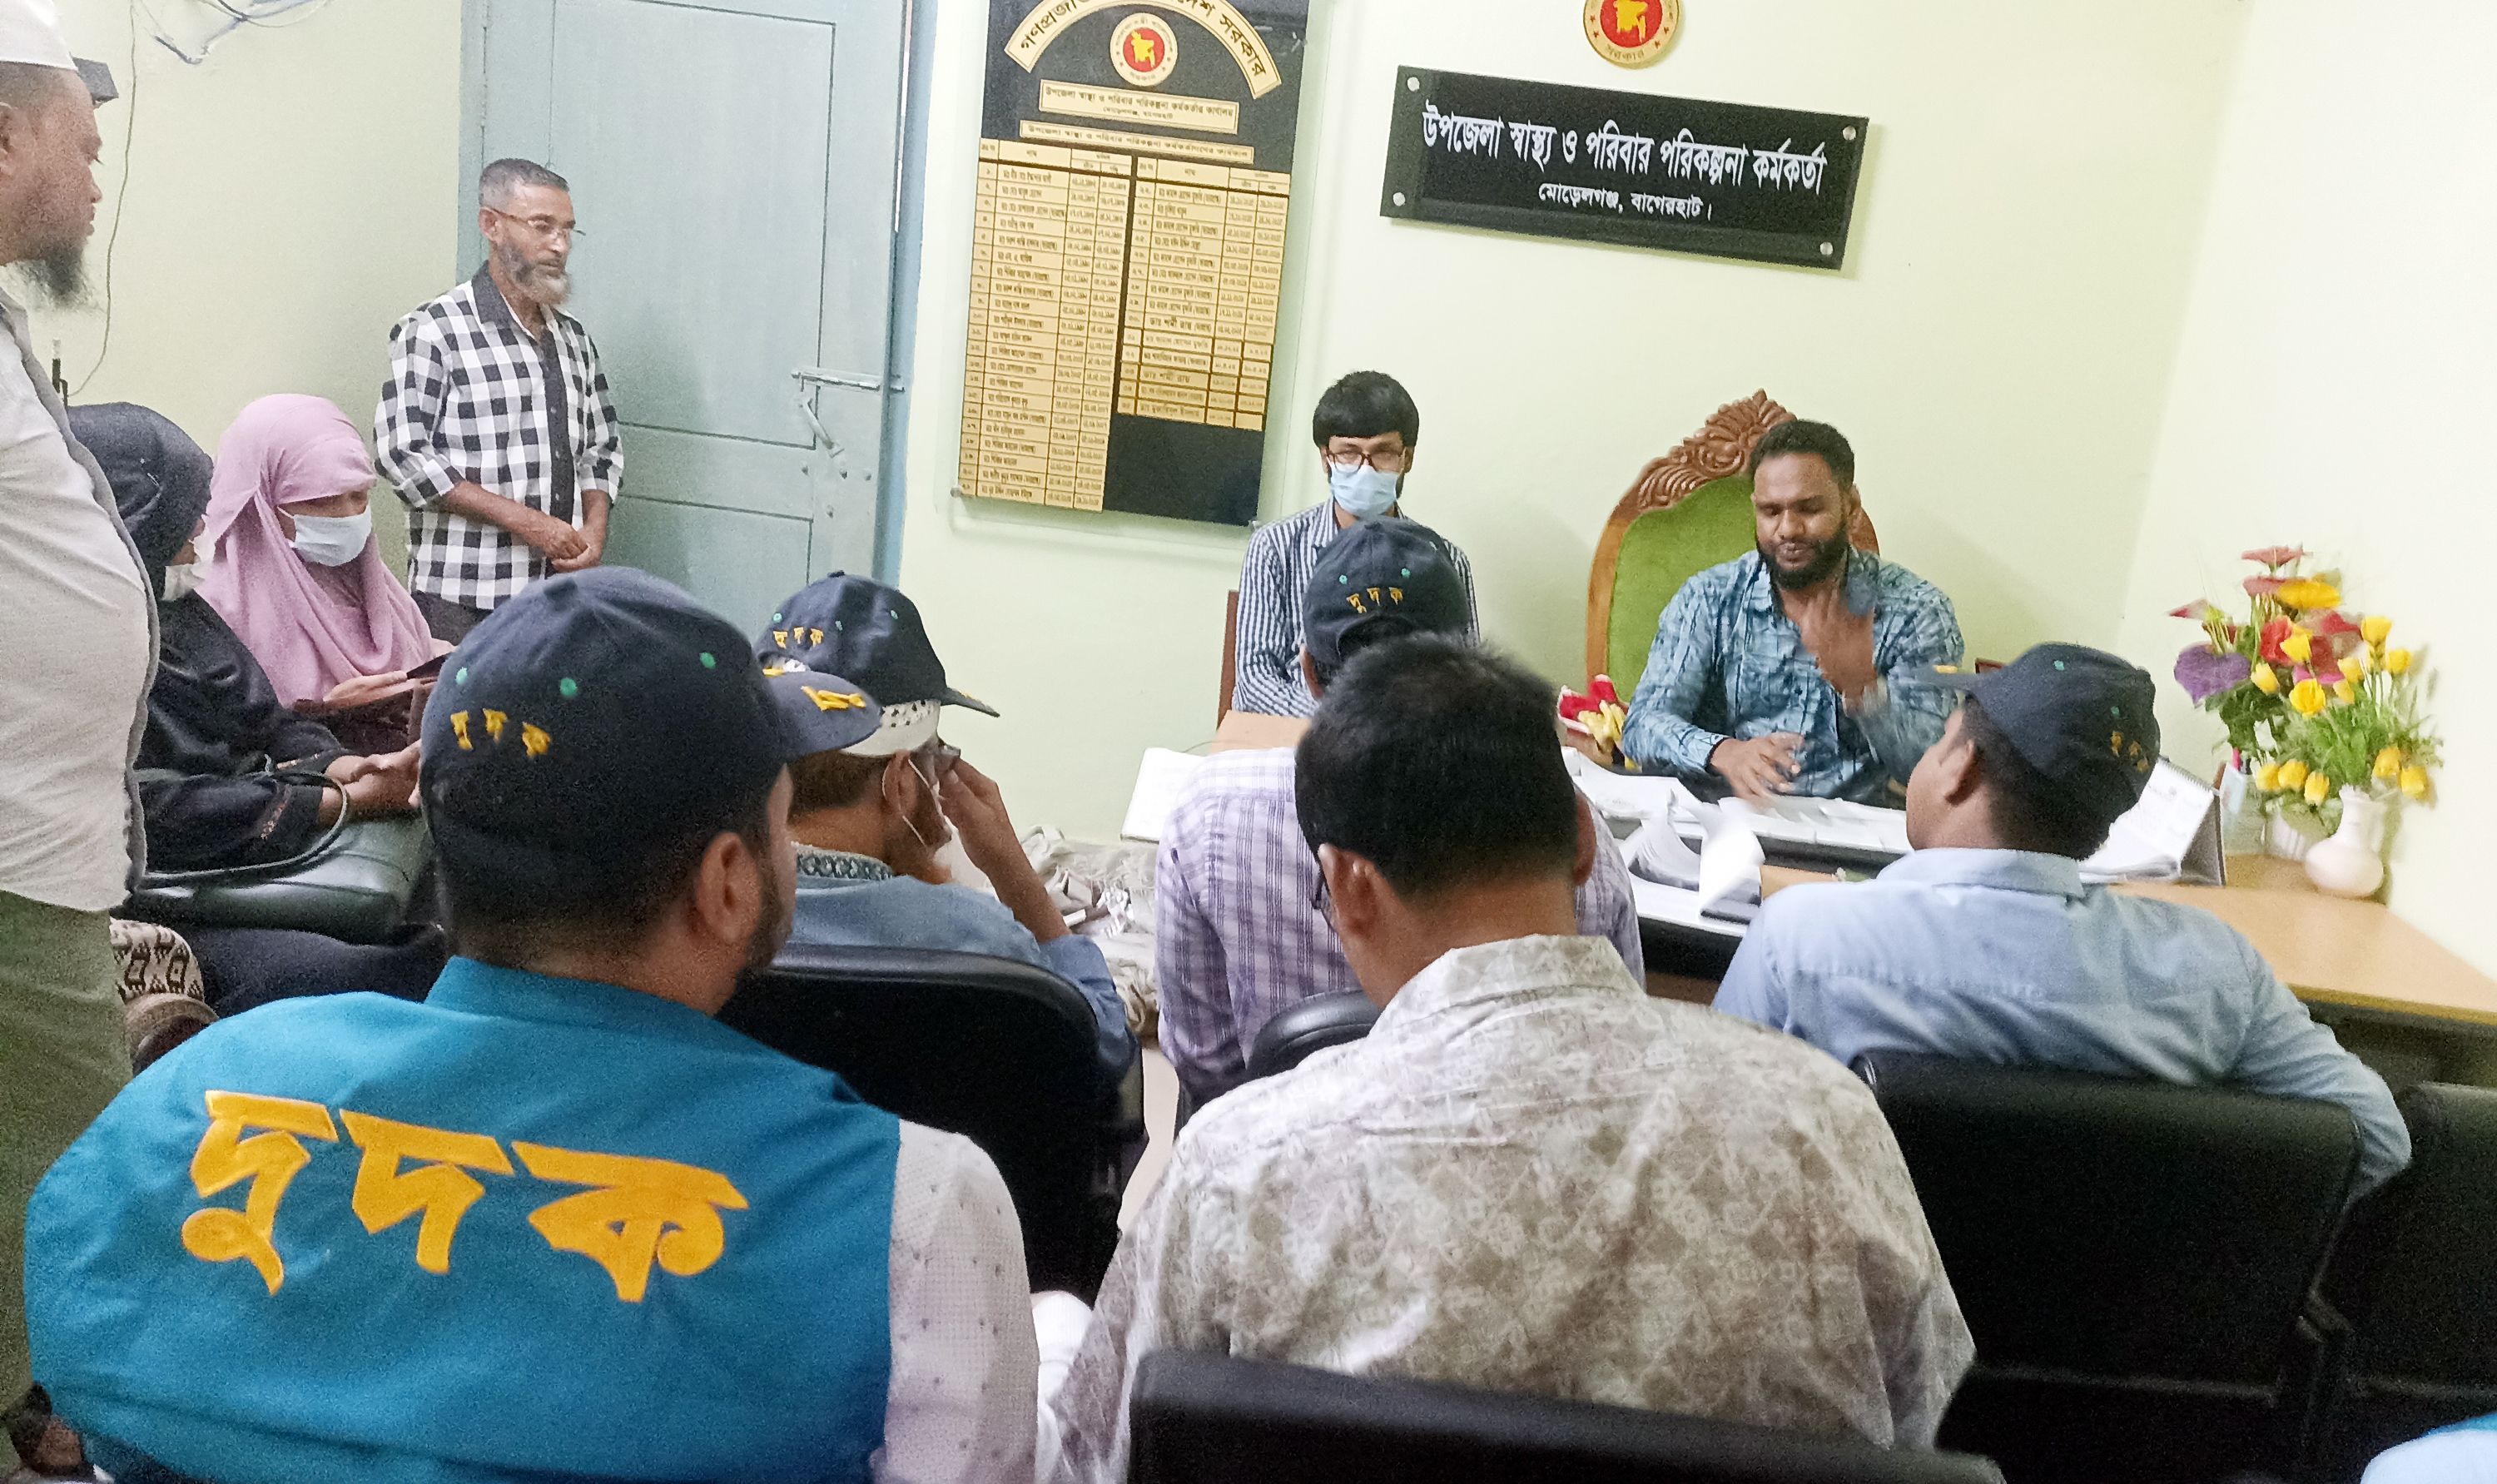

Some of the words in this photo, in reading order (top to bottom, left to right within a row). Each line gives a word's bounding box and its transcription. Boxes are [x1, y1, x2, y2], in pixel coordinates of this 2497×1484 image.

[1219, 13, 1266, 76] সরকার
[1422, 99, 1505, 160] উপজেলা
[1508, 119, 1558, 173] স্বাস্থ্য
[1562, 131, 1578, 165] ও
[1586, 119, 1656, 176] পরিবার
[1660, 127, 1750, 187] পরিকল্পনা
[1752, 137, 1829, 196] কর্মকর্তা
[181, 1089, 749, 1304] দুদক
